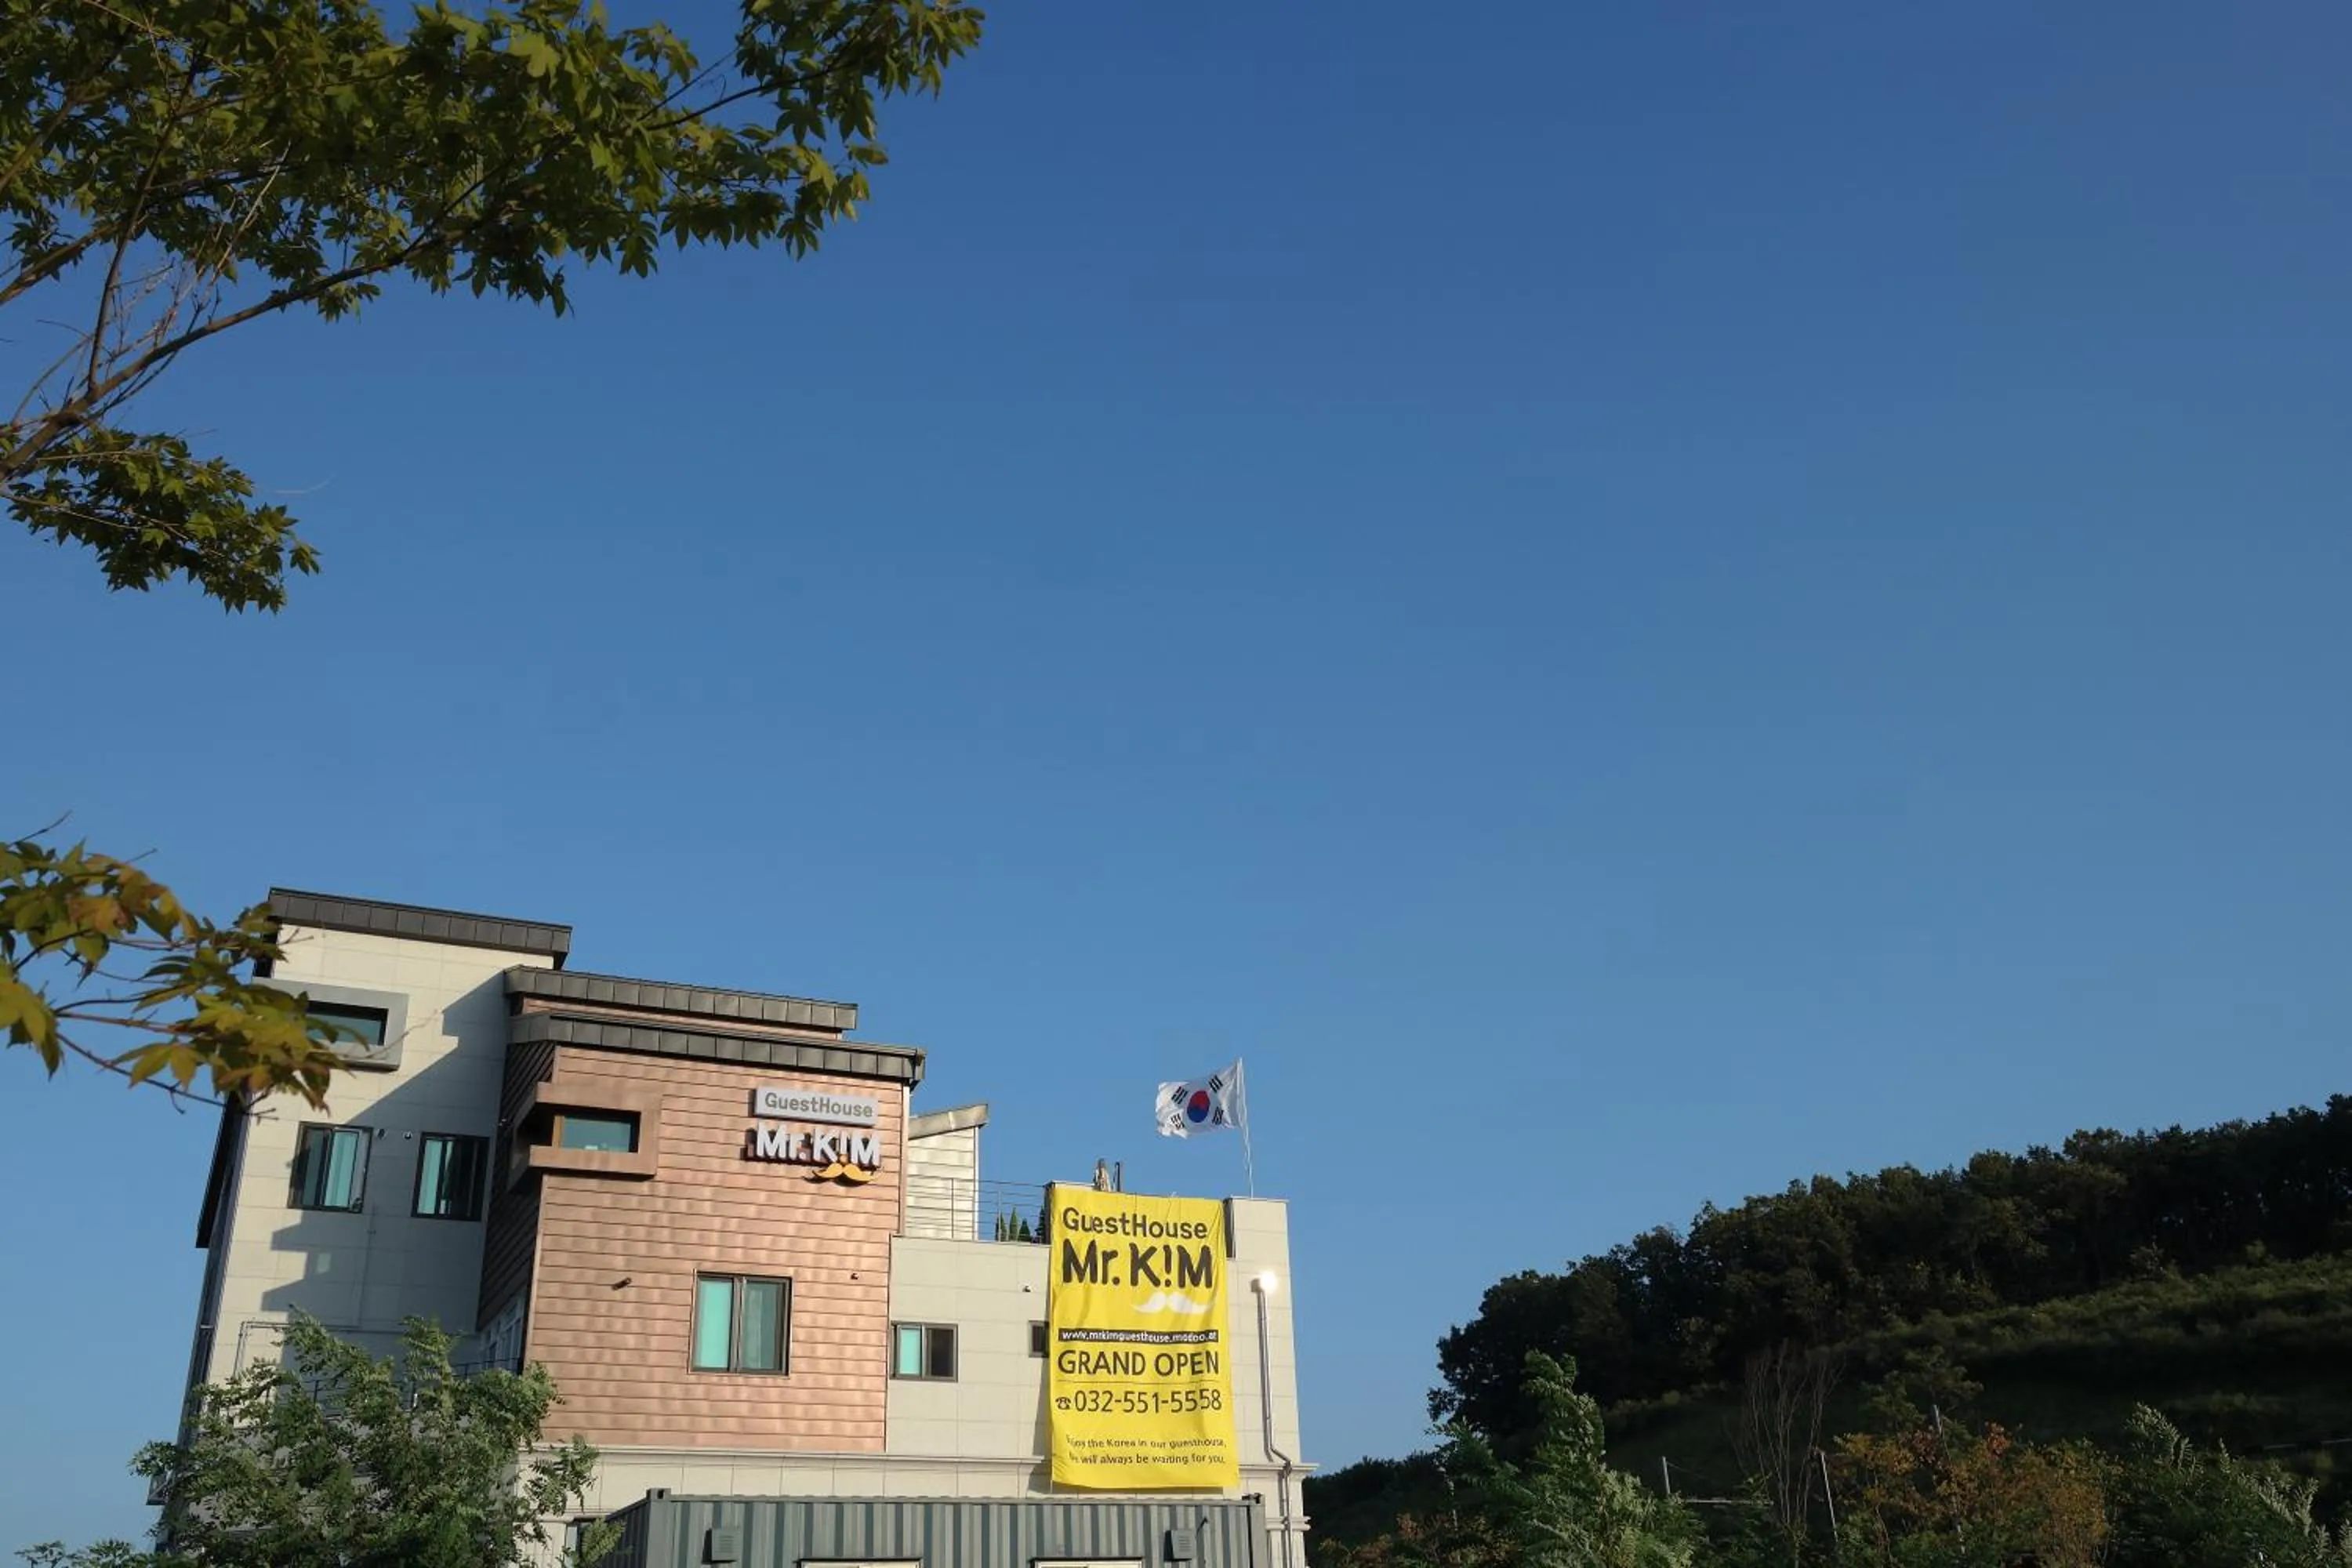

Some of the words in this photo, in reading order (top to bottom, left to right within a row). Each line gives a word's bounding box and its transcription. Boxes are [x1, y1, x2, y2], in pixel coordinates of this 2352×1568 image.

[764, 1092, 873, 1117] GuestHouse
[1062, 1207, 1207, 1239] GuestHouse
[1058, 1349, 1146, 1376] GRAND
[1154, 1350, 1219, 1377] OPEN
[1074, 1388, 1222, 1414] 032-551-5558
[1087, 1439, 1105, 1448] the
[1106, 1439, 1136, 1447] Korea
[1100, 1454, 1133, 1465] always
[1136, 1454, 1149, 1464] be
[1152, 1455, 1189, 1465] waiting
[1191, 1454, 1206, 1463] for
